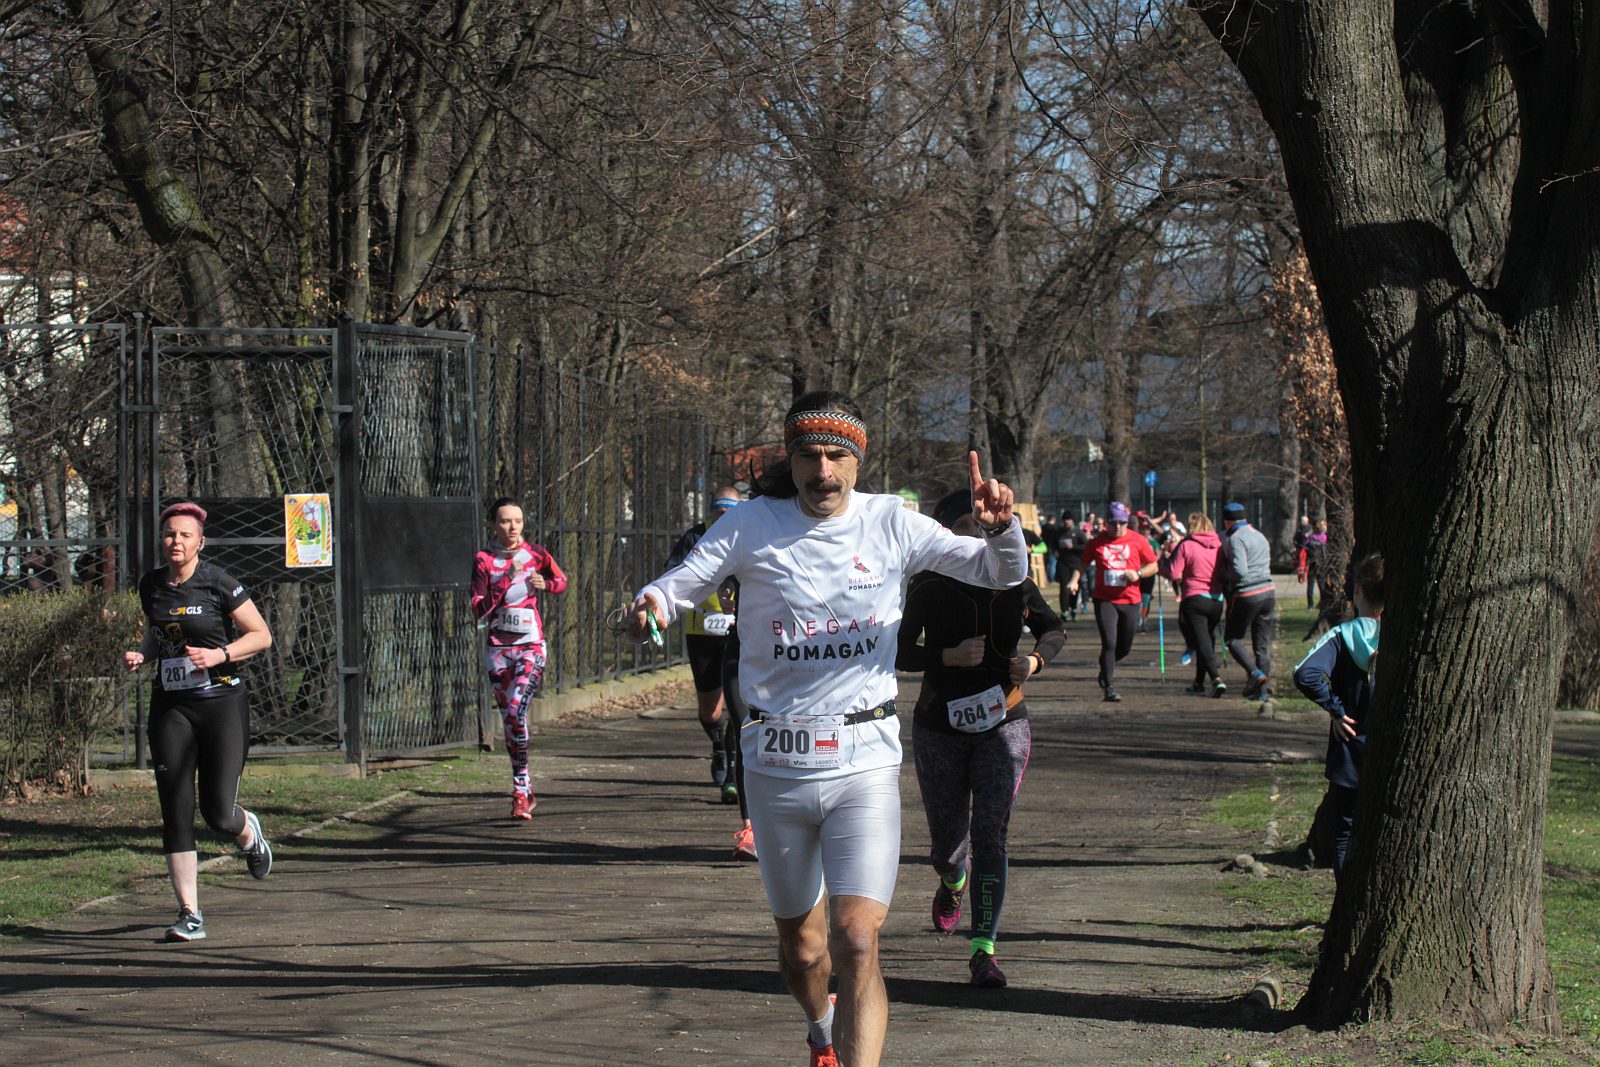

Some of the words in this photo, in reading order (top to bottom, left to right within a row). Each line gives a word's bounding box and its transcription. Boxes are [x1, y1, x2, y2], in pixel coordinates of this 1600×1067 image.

[186, 605, 203, 615] GLS
[501, 614, 520, 626] 146
[707, 618, 727, 630] 222
[165, 666, 187, 683] 287
[953, 703, 987, 728] 264
[764, 727, 810, 755] 200
[977, 873, 1000, 932] Kalenji
